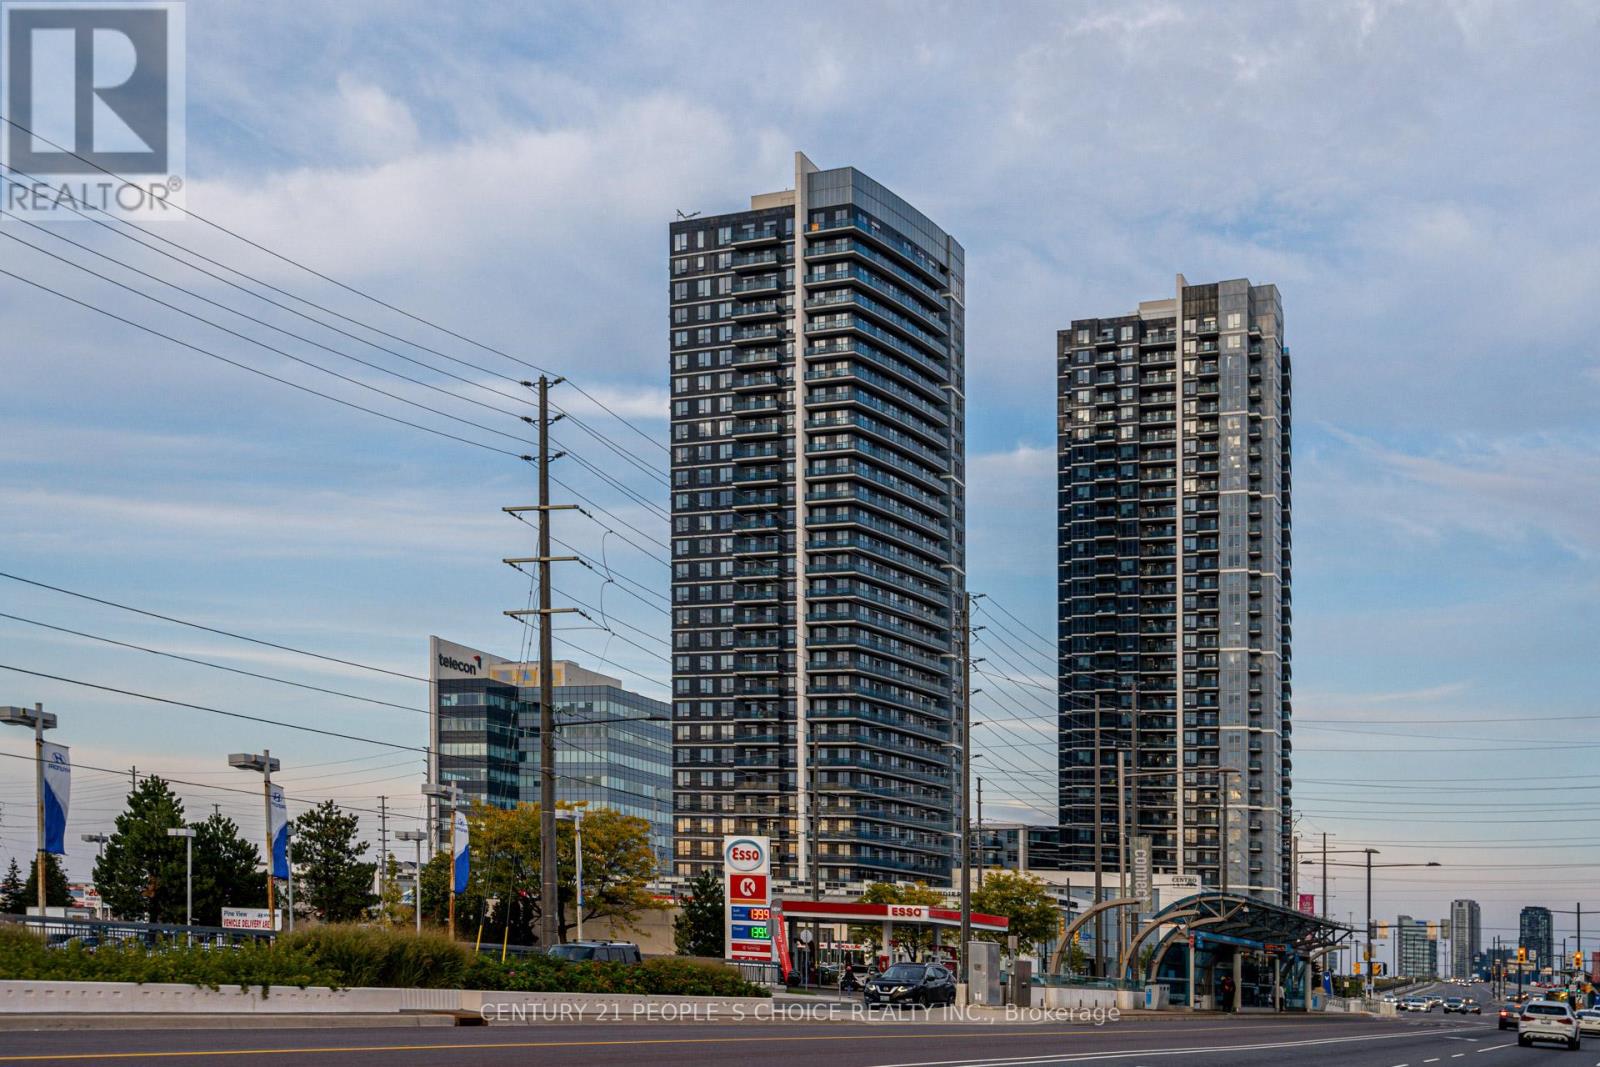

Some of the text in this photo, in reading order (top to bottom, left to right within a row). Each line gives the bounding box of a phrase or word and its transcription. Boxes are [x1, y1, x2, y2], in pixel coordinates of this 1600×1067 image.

[438, 653, 476, 675] telecon
[744, 881, 755, 895] K
[892, 907, 921, 917] ESSO
[224, 919, 241, 927] VEHICLE
[242, 920, 261, 928] DELIVERY
